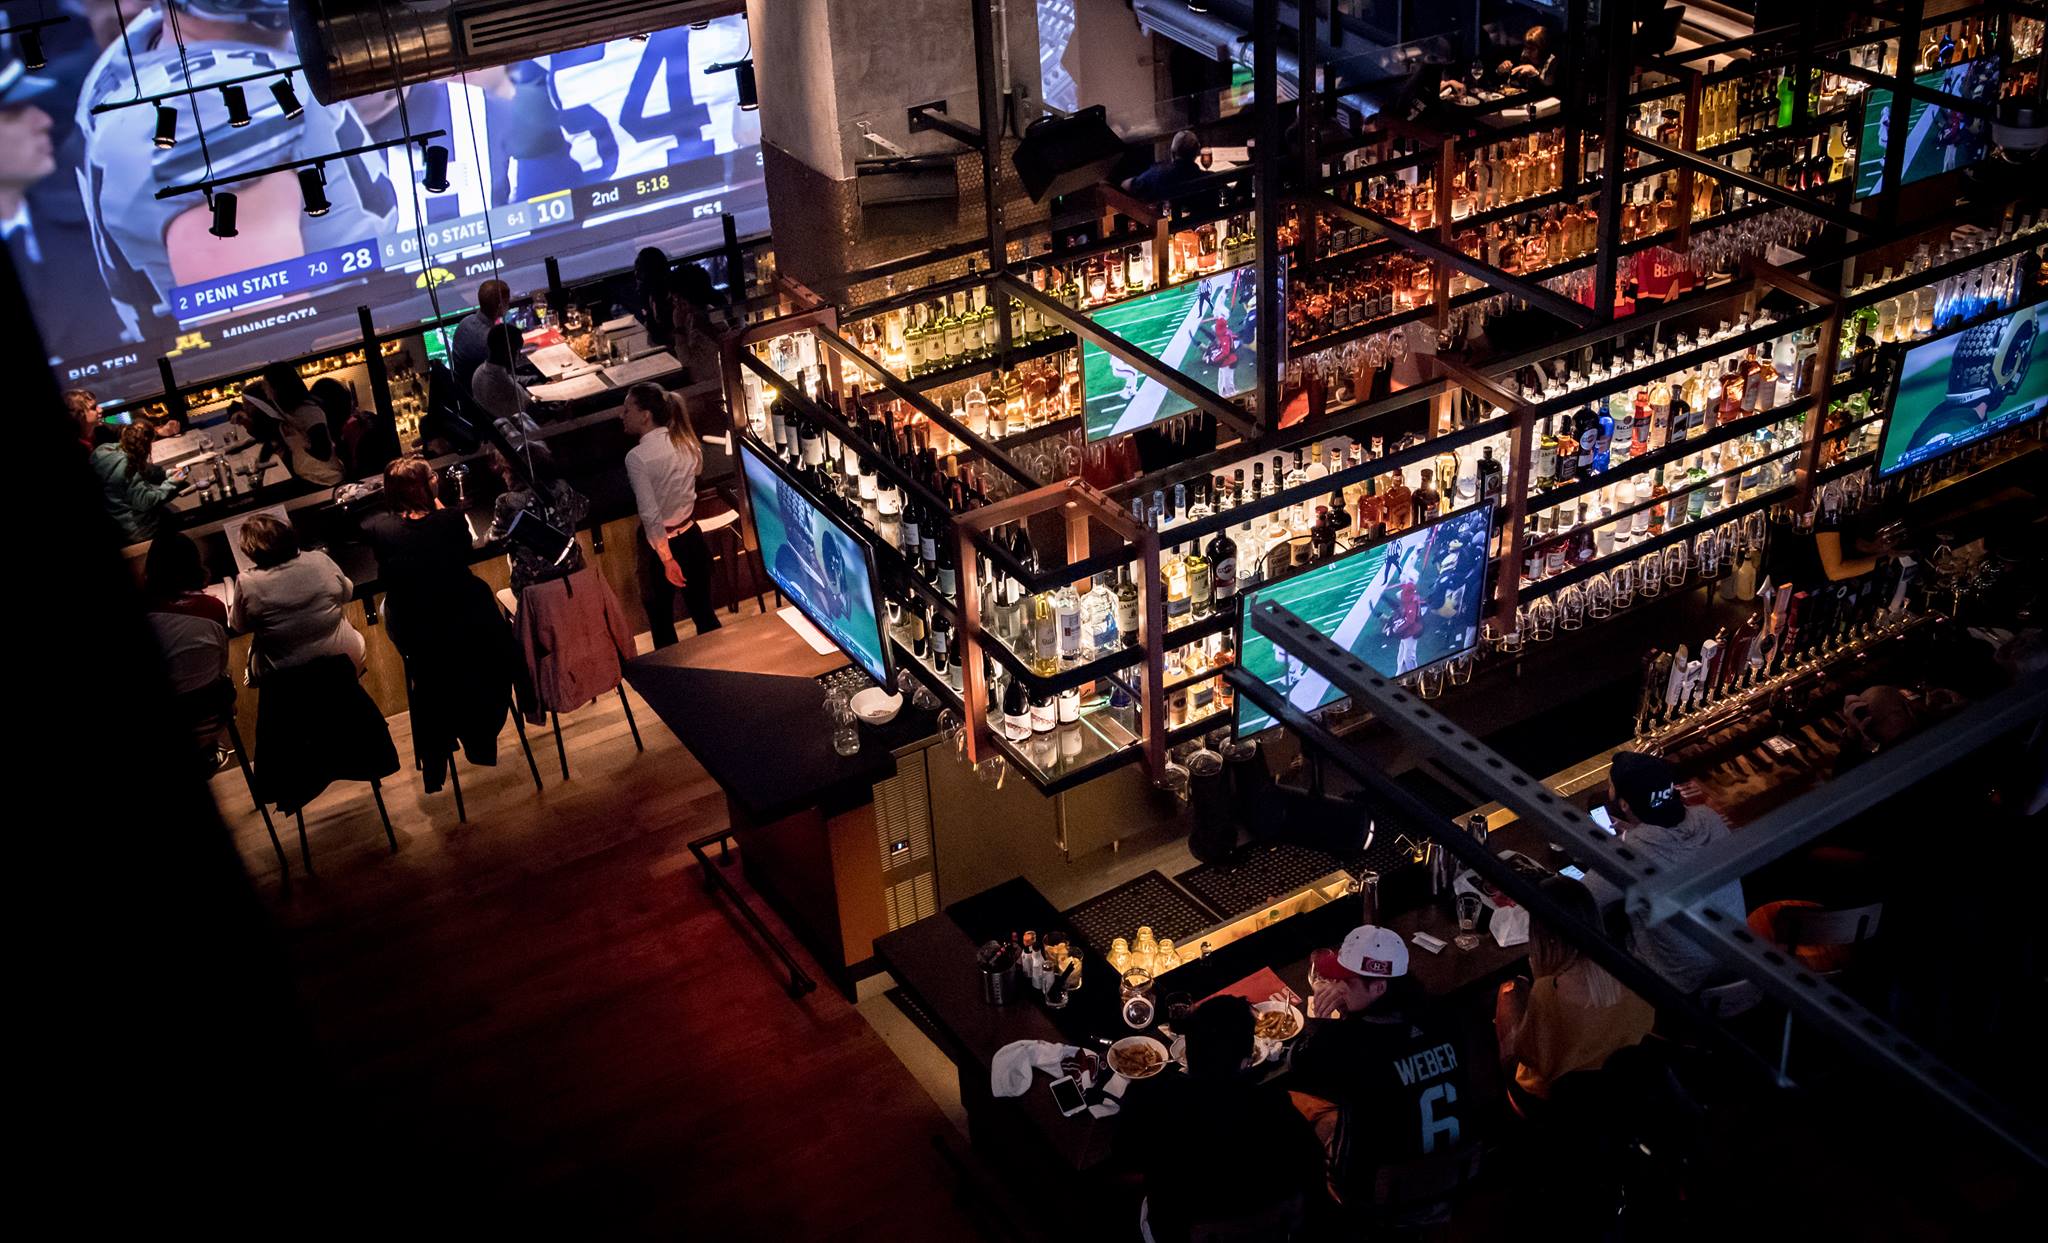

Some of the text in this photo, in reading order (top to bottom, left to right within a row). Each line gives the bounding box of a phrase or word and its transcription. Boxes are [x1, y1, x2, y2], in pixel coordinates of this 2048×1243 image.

[591, 175, 670, 207] 2nd 5:18
[385, 199, 566, 257] 6 OHO STATE 6-1 10
[179, 247, 373, 310] 2 PENN STATE 7-0 28
[1393, 1042, 1458, 1086] WEBER
[1419, 1082, 1460, 1154] 6
